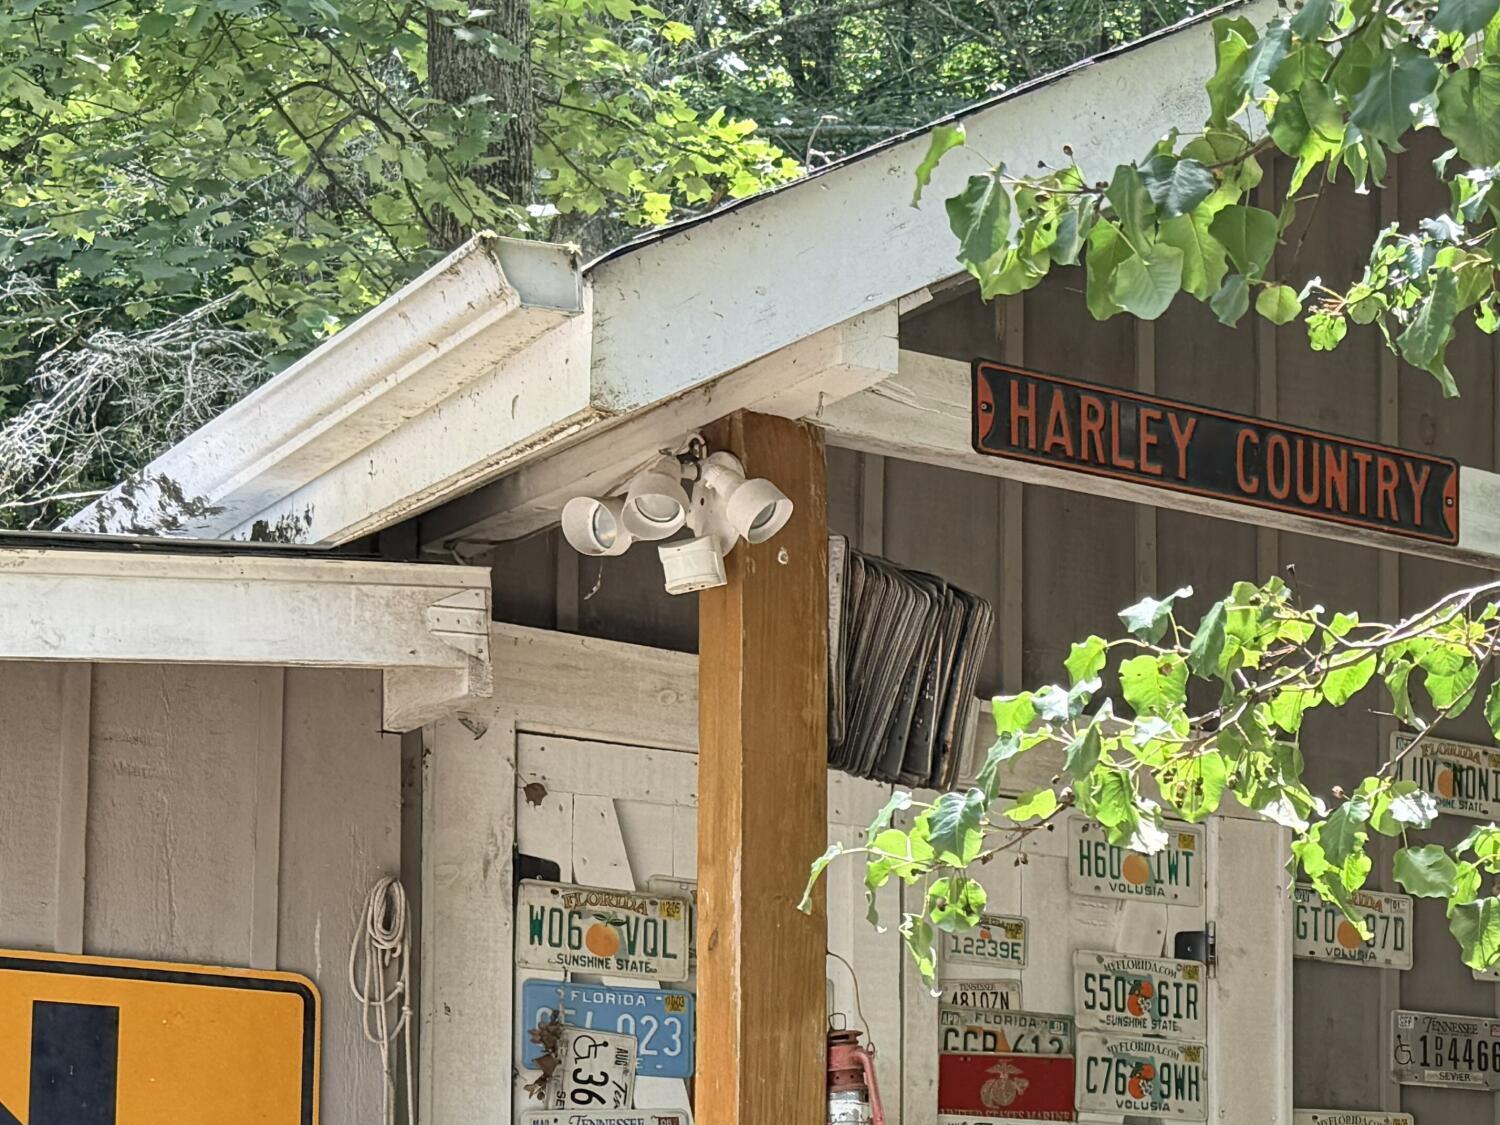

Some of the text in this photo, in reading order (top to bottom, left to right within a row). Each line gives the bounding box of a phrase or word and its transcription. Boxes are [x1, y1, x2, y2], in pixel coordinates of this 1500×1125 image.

[1009, 379, 1431, 526] HARLEY COUNTRY
[1421, 743, 1481, 765] FLORIDA
[1079, 840, 1193, 887] H60 IWT
[1109, 882, 1166, 897] VOLUSIA
[562, 892, 648, 916] FLORIDA
[530, 905, 582, 950] W06
[951, 935, 1021, 960] 12239E
[1326, 948, 1376, 960] VOLUSIA
[556, 953, 651, 973] SUNSHINE STATE
[571, 991, 646, 1006] FLORIDA
[1085, 973, 1198, 1020] S50 6IR
[975, 1013, 1036, 1028] FLORIDA
[1106, 1015, 1178, 1032] SUNSHINE STATE
[1423, 1016, 1478, 1034] TENNESSEE
[614, 1047, 629, 1066] AUG
[1086, 1056, 1200, 1101] C76 9WH
[1439, 1072, 1471, 1081] SEVIER
[1116, 1100, 1170, 1111] VOLUSIA
